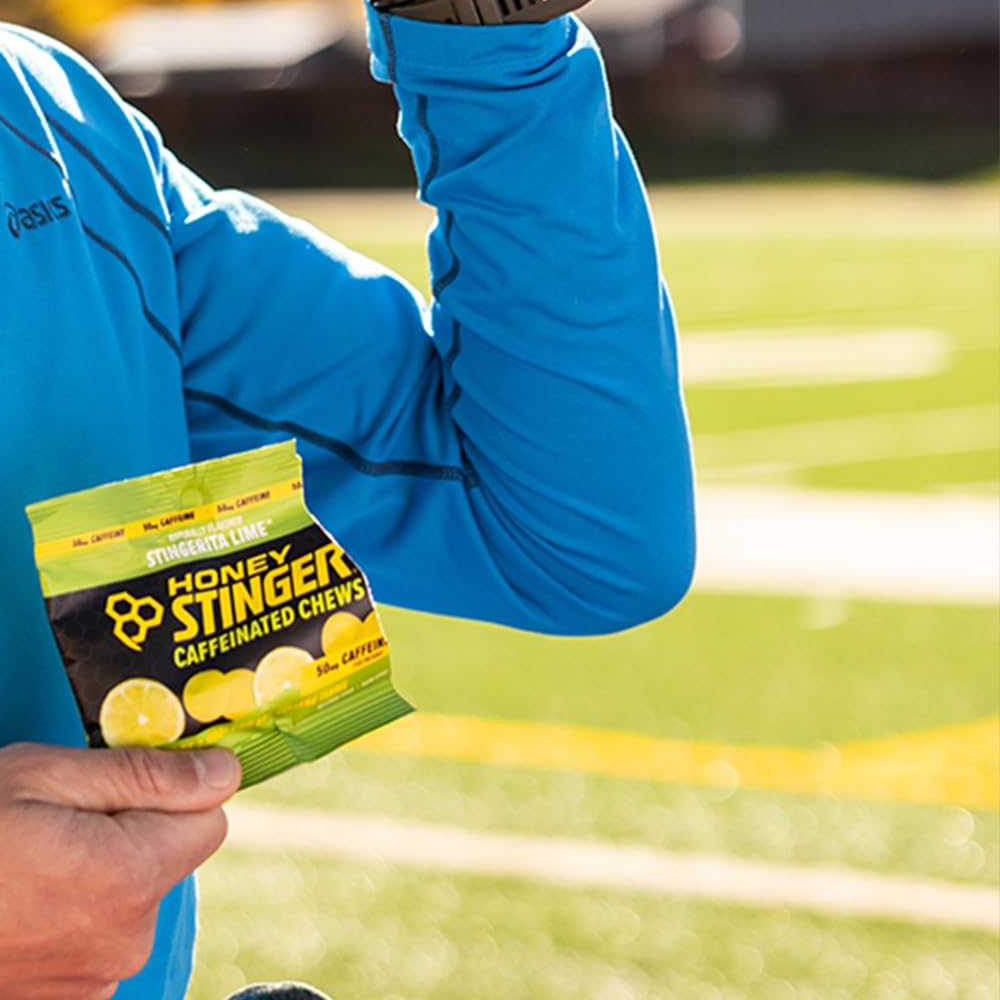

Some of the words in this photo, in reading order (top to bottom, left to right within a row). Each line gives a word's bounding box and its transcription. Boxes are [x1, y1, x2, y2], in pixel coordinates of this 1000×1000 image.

[145, 532, 230, 569] STINGERITA
[167, 543, 292, 597] HONEY
[171, 542, 352, 643] STINGER
[173, 605, 296, 669] CAFFEINATED
[297, 577, 366, 620] CHEWS
